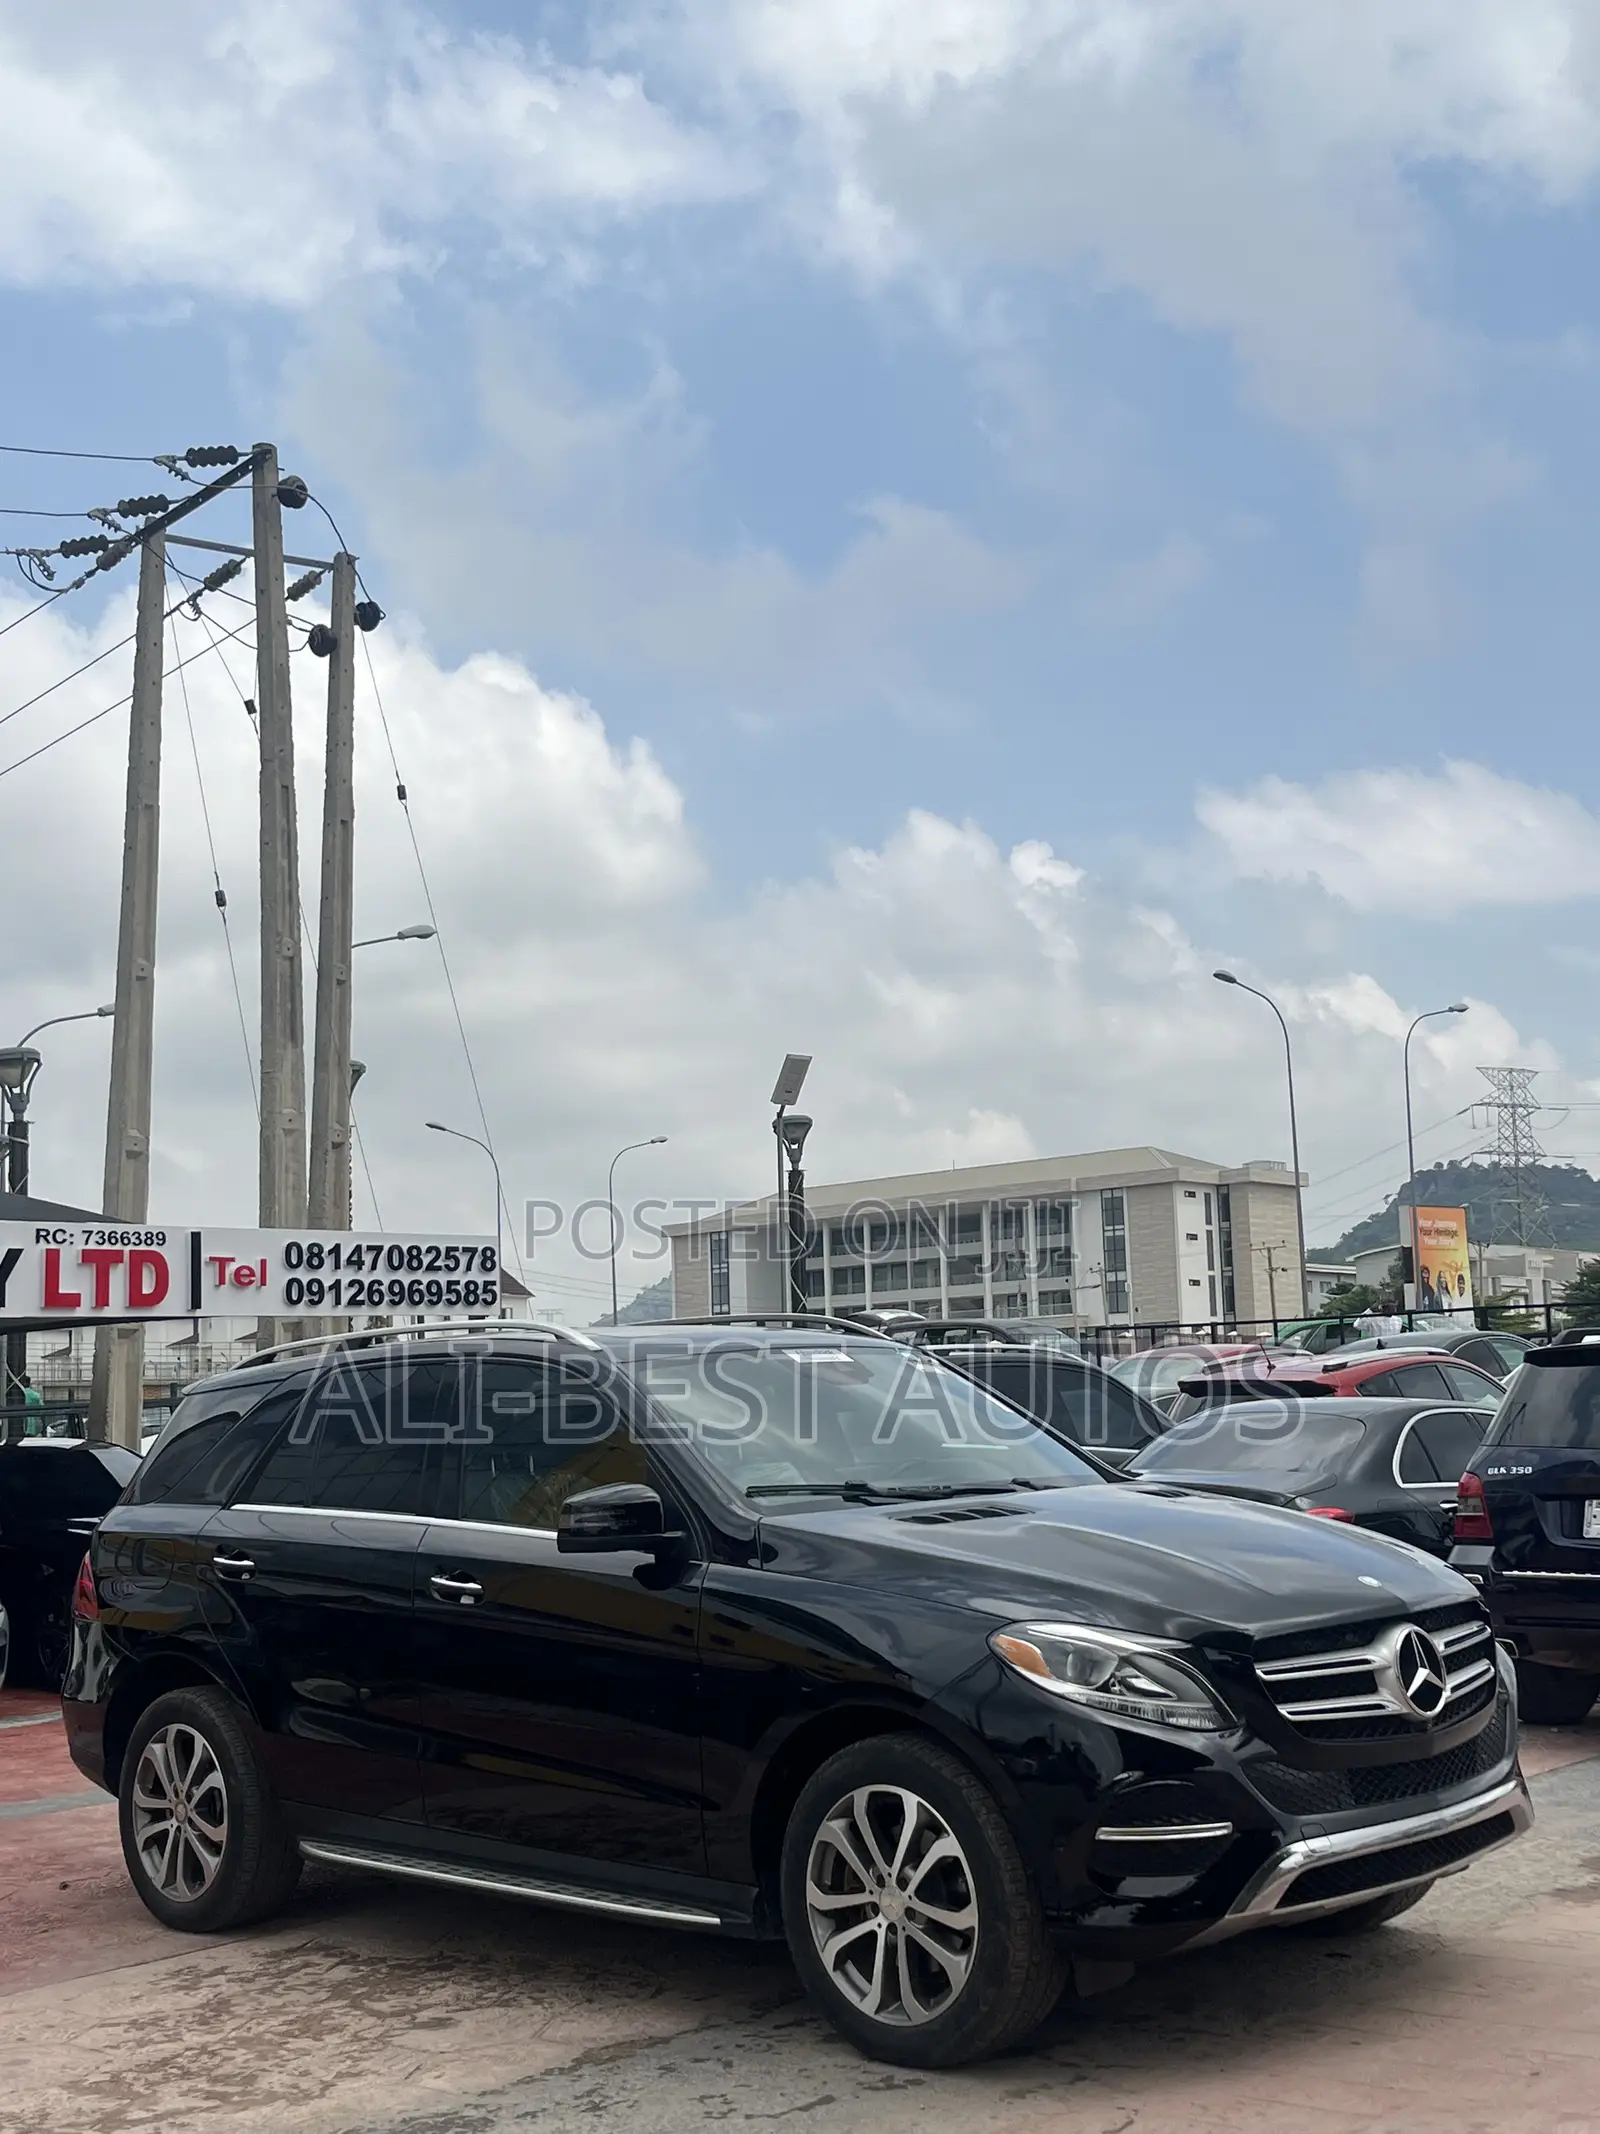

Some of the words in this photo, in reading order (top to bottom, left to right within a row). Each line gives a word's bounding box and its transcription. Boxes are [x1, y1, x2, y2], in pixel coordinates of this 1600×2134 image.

[35, 1228, 74, 1245] RC:
[82, 1229, 167, 1246] 7366389
[284, 1241, 497, 1272] 08147082578
[42, 1248, 170, 1308] LTD
[208, 1256, 267, 1287] Tel
[284, 1277, 498, 1306] 09126969585
[1487, 1466, 1507, 1475] GLK
[1509, 1466, 1533, 1475] 350
